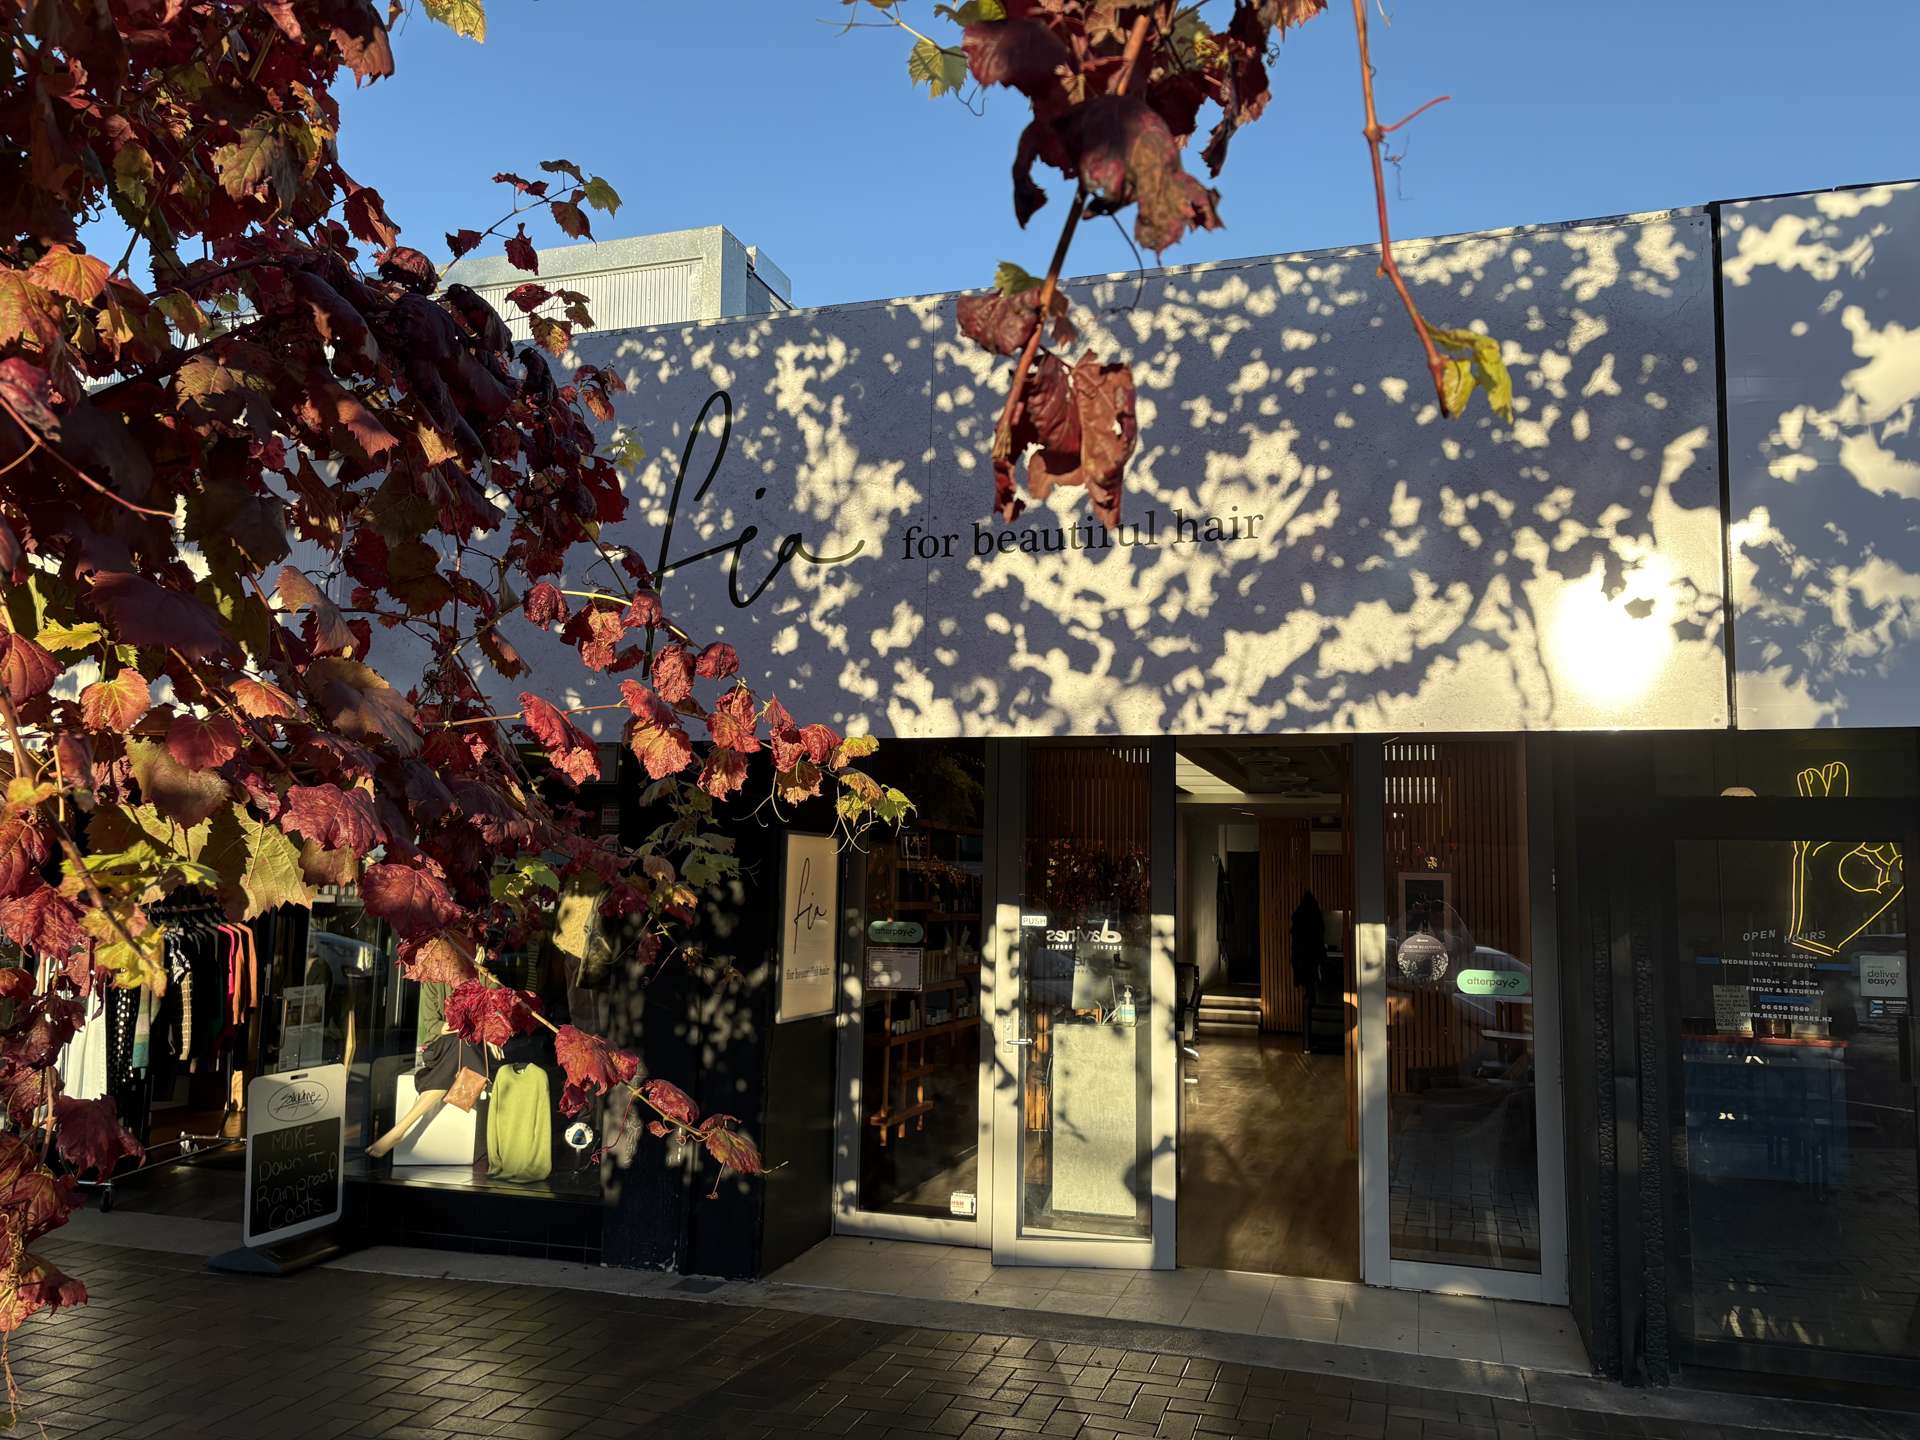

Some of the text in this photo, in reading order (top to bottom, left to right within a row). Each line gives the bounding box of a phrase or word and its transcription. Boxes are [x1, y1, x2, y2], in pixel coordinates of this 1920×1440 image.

[901, 526, 959, 560] for
[1173, 506, 1264, 545] hair
[1743, 929, 1775, 941] OPEN
[1467, 977, 1509, 987] afterpay
[1868, 978, 1889, 987] easy
